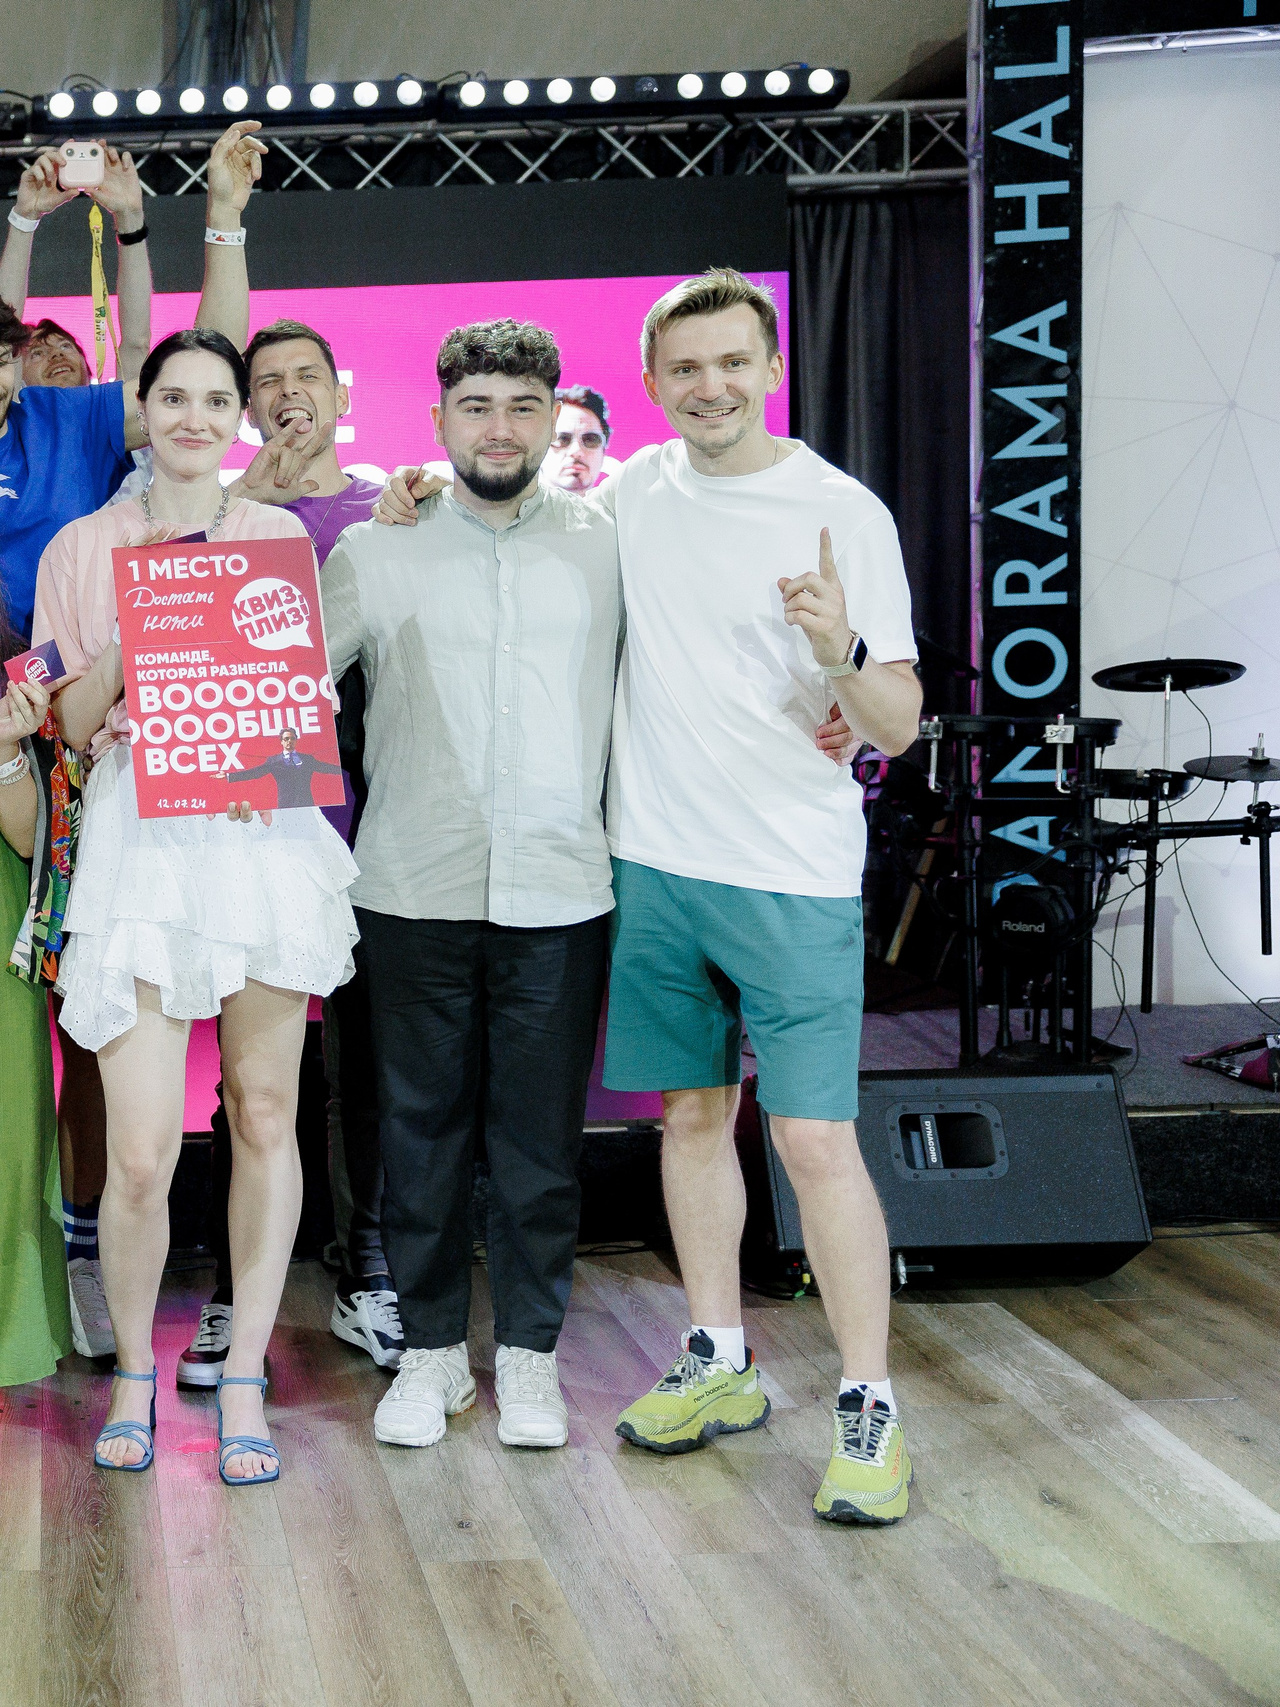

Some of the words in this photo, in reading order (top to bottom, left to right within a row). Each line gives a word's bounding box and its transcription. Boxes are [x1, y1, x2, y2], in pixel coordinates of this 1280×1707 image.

[992, 0, 1072, 245] HAL
[127, 559, 141, 581] 1
[148, 554, 249, 581] МЕСТО
[125, 586, 215, 609] Достать
[232, 585, 297, 621] КВИЗ
[989, 299, 1069, 906] AORAMA
[142, 613, 205, 633] ножи
[134, 649, 215, 666] КОМАНДЕ,
[136, 666, 208, 682] КОТОРАЯ
[210, 661, 290, 677] РАЗНЕСЛА
[144, 742, 246, 777] ВСЕХ
[1001, 920, 1046, 933] Roland
[924, 1120, 938, 1163] DYNACORD
[693, 1394, 705, 1403] new
[705, 1381, 729, 1397] balance
